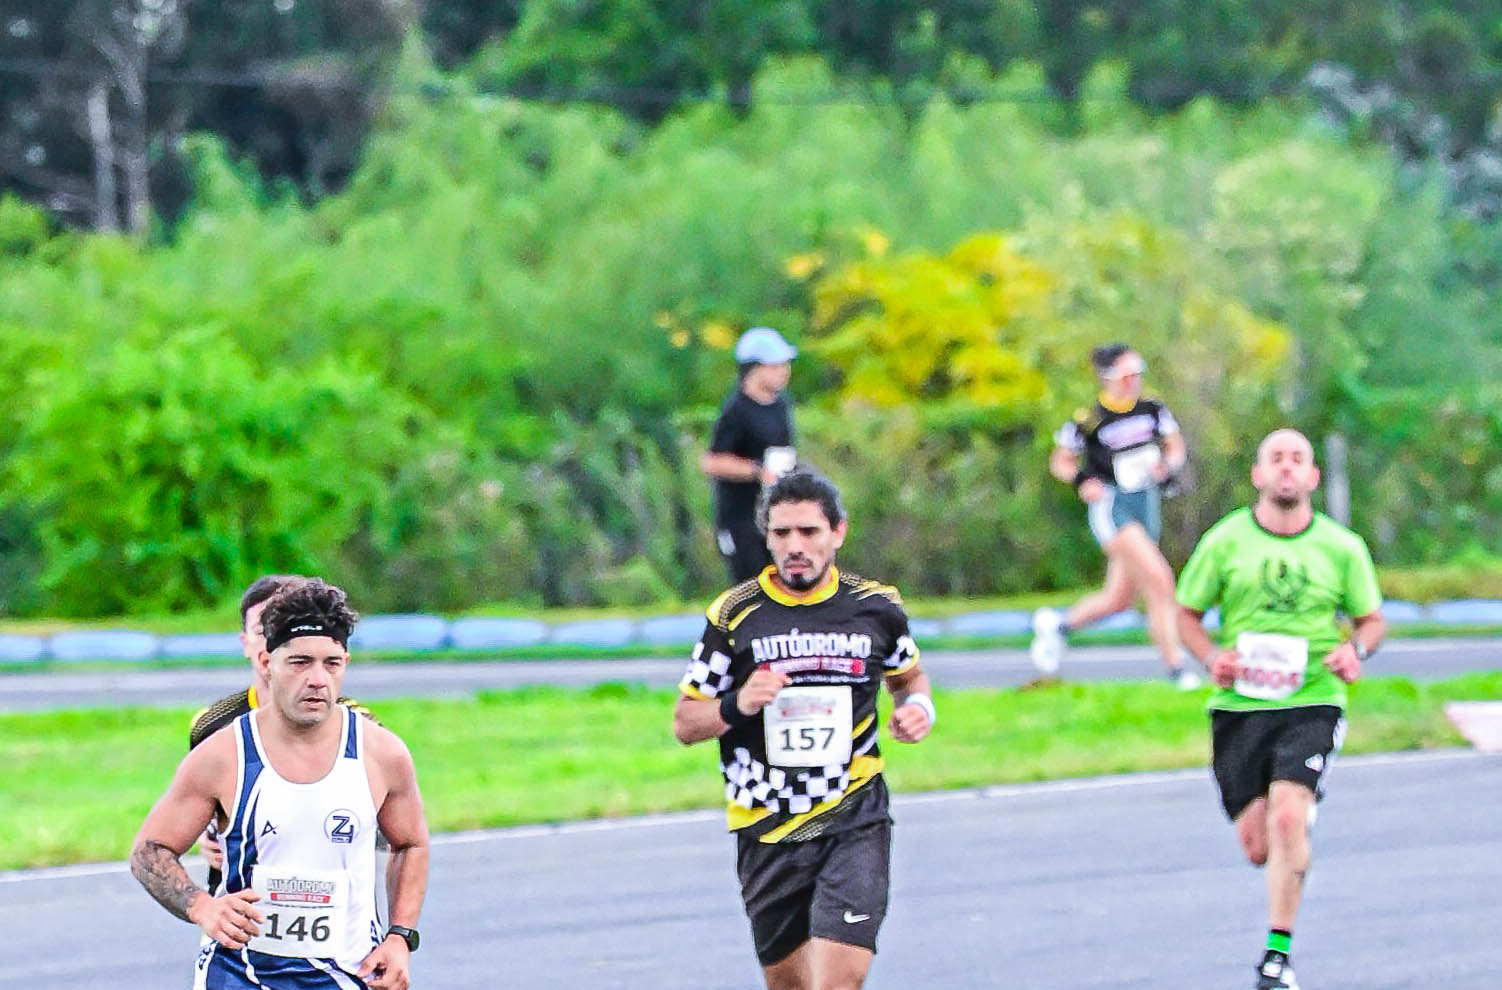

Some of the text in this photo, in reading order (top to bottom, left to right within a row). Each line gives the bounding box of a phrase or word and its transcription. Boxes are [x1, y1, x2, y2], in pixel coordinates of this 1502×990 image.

[752, 628, 872, 663] AUTÓDROMO
[780, 727, 835, 751] 157
[265, 913, 331, 942] 146
